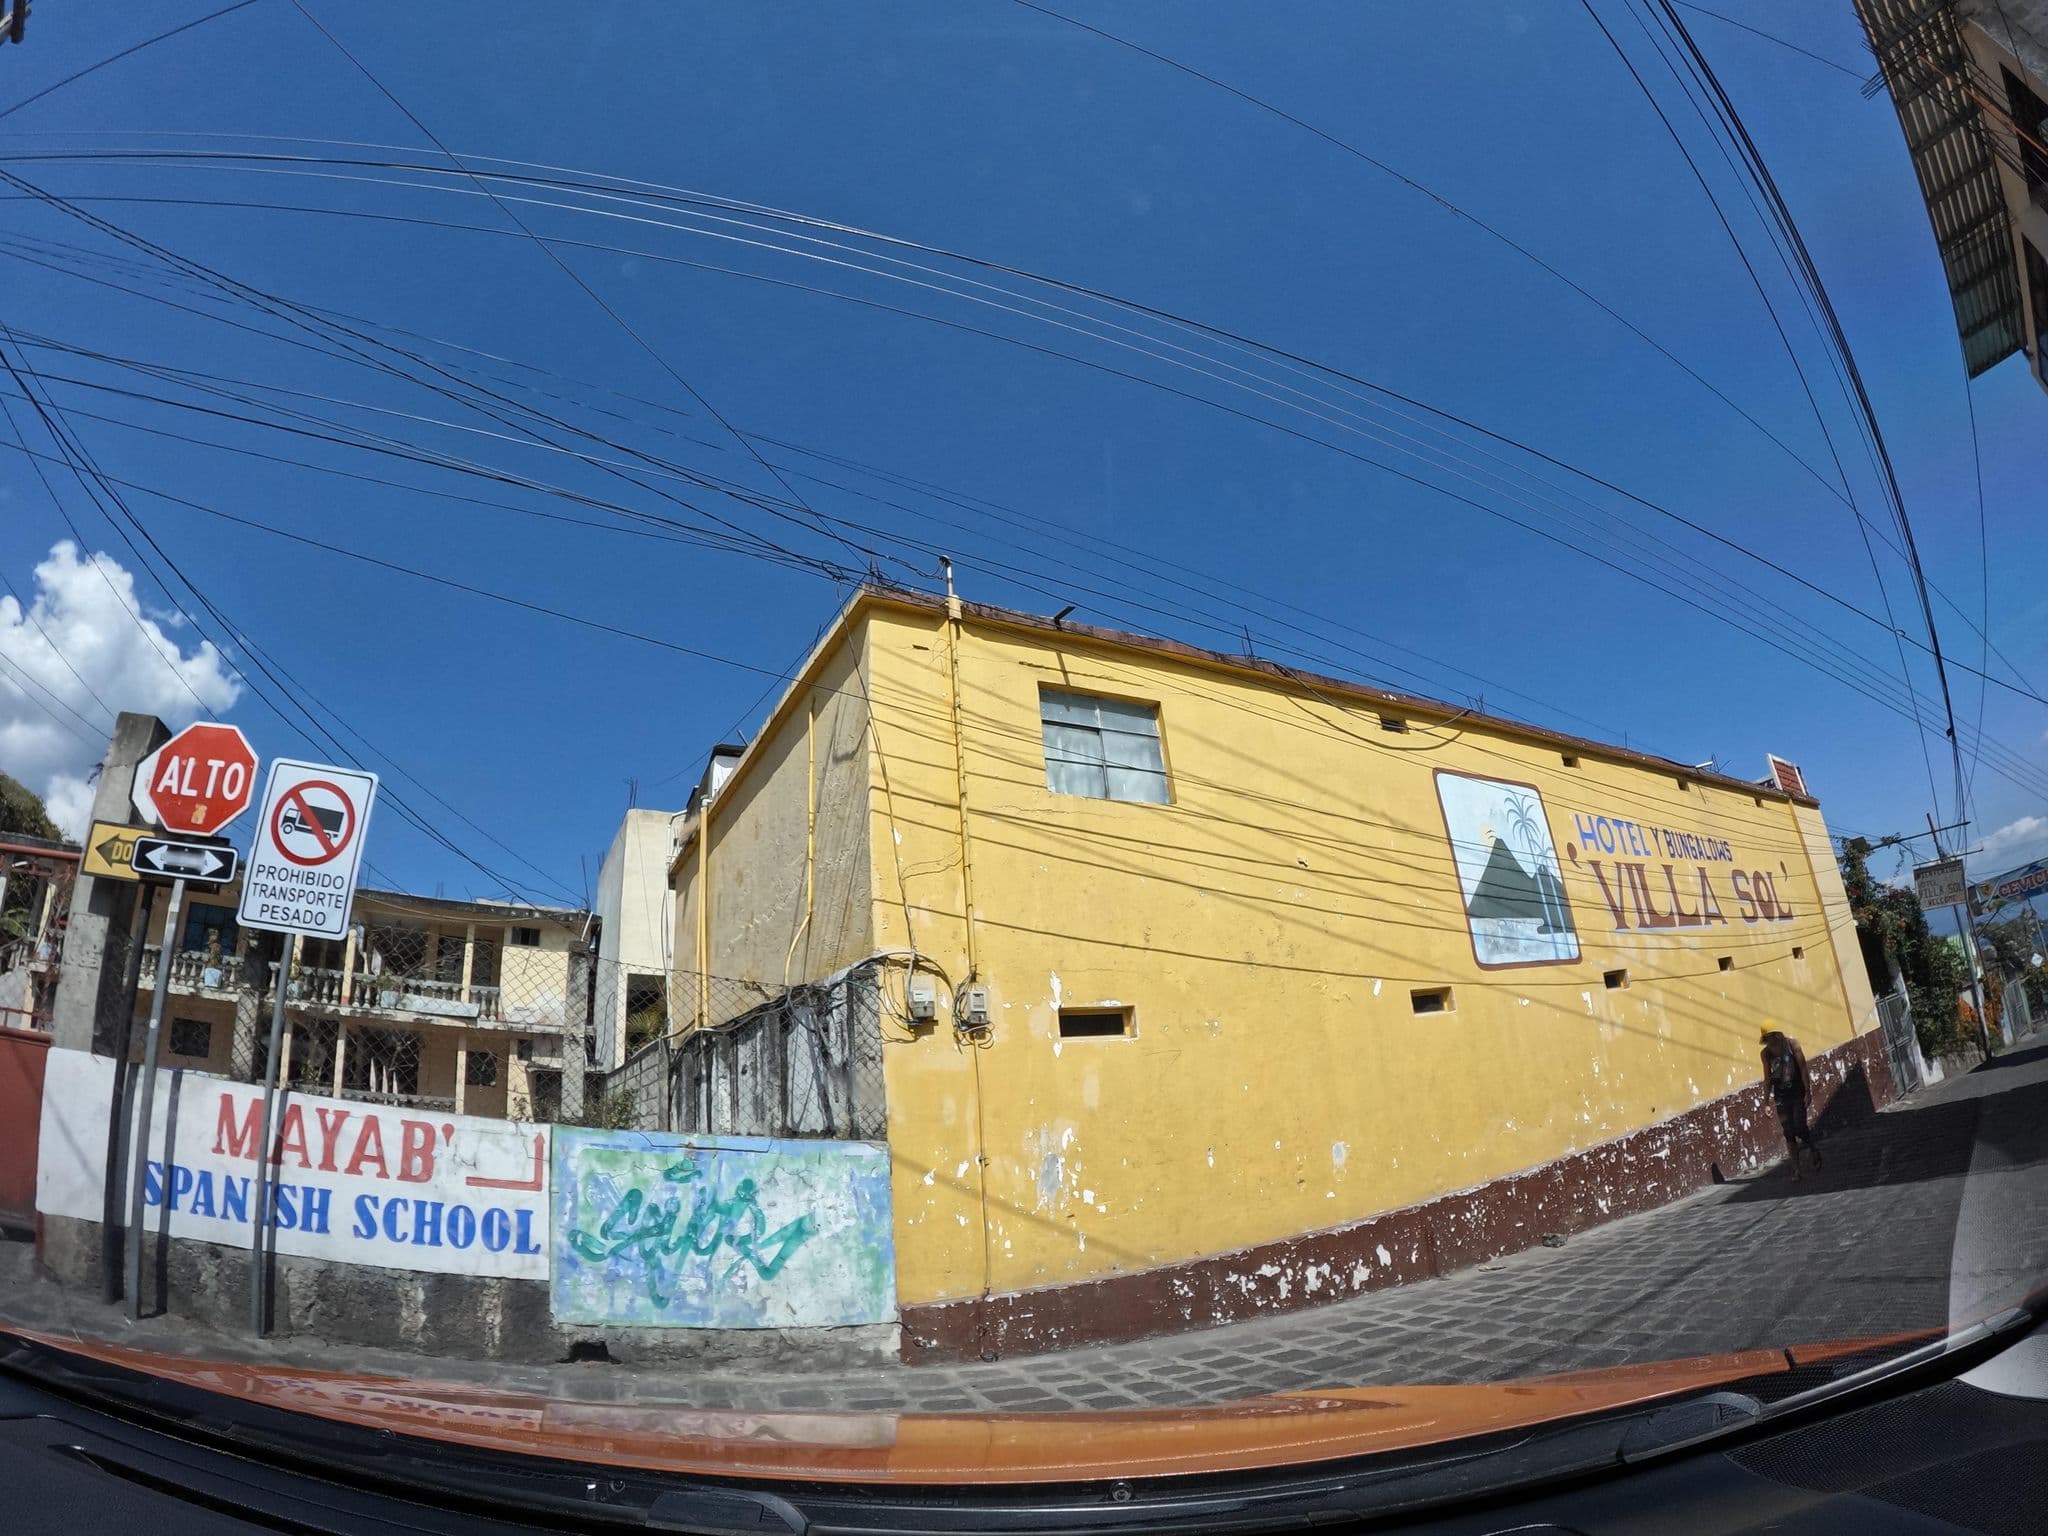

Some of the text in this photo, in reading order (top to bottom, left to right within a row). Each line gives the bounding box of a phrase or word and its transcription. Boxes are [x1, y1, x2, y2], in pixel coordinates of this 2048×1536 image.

[157, 755, 245, 801] ALTO
[1574, 813, 1733, 863] HOTEL Y BUNGALOWS
[256, 864, 345, 890] PROHIBIDO
[251, 882, 344, 909] TRANSPORTE
[259, 903, 327, 927] PESADO
[144, 1160, 332, 1233] SPANISH
[353, 1193, 541, 1255] SCHOOL
